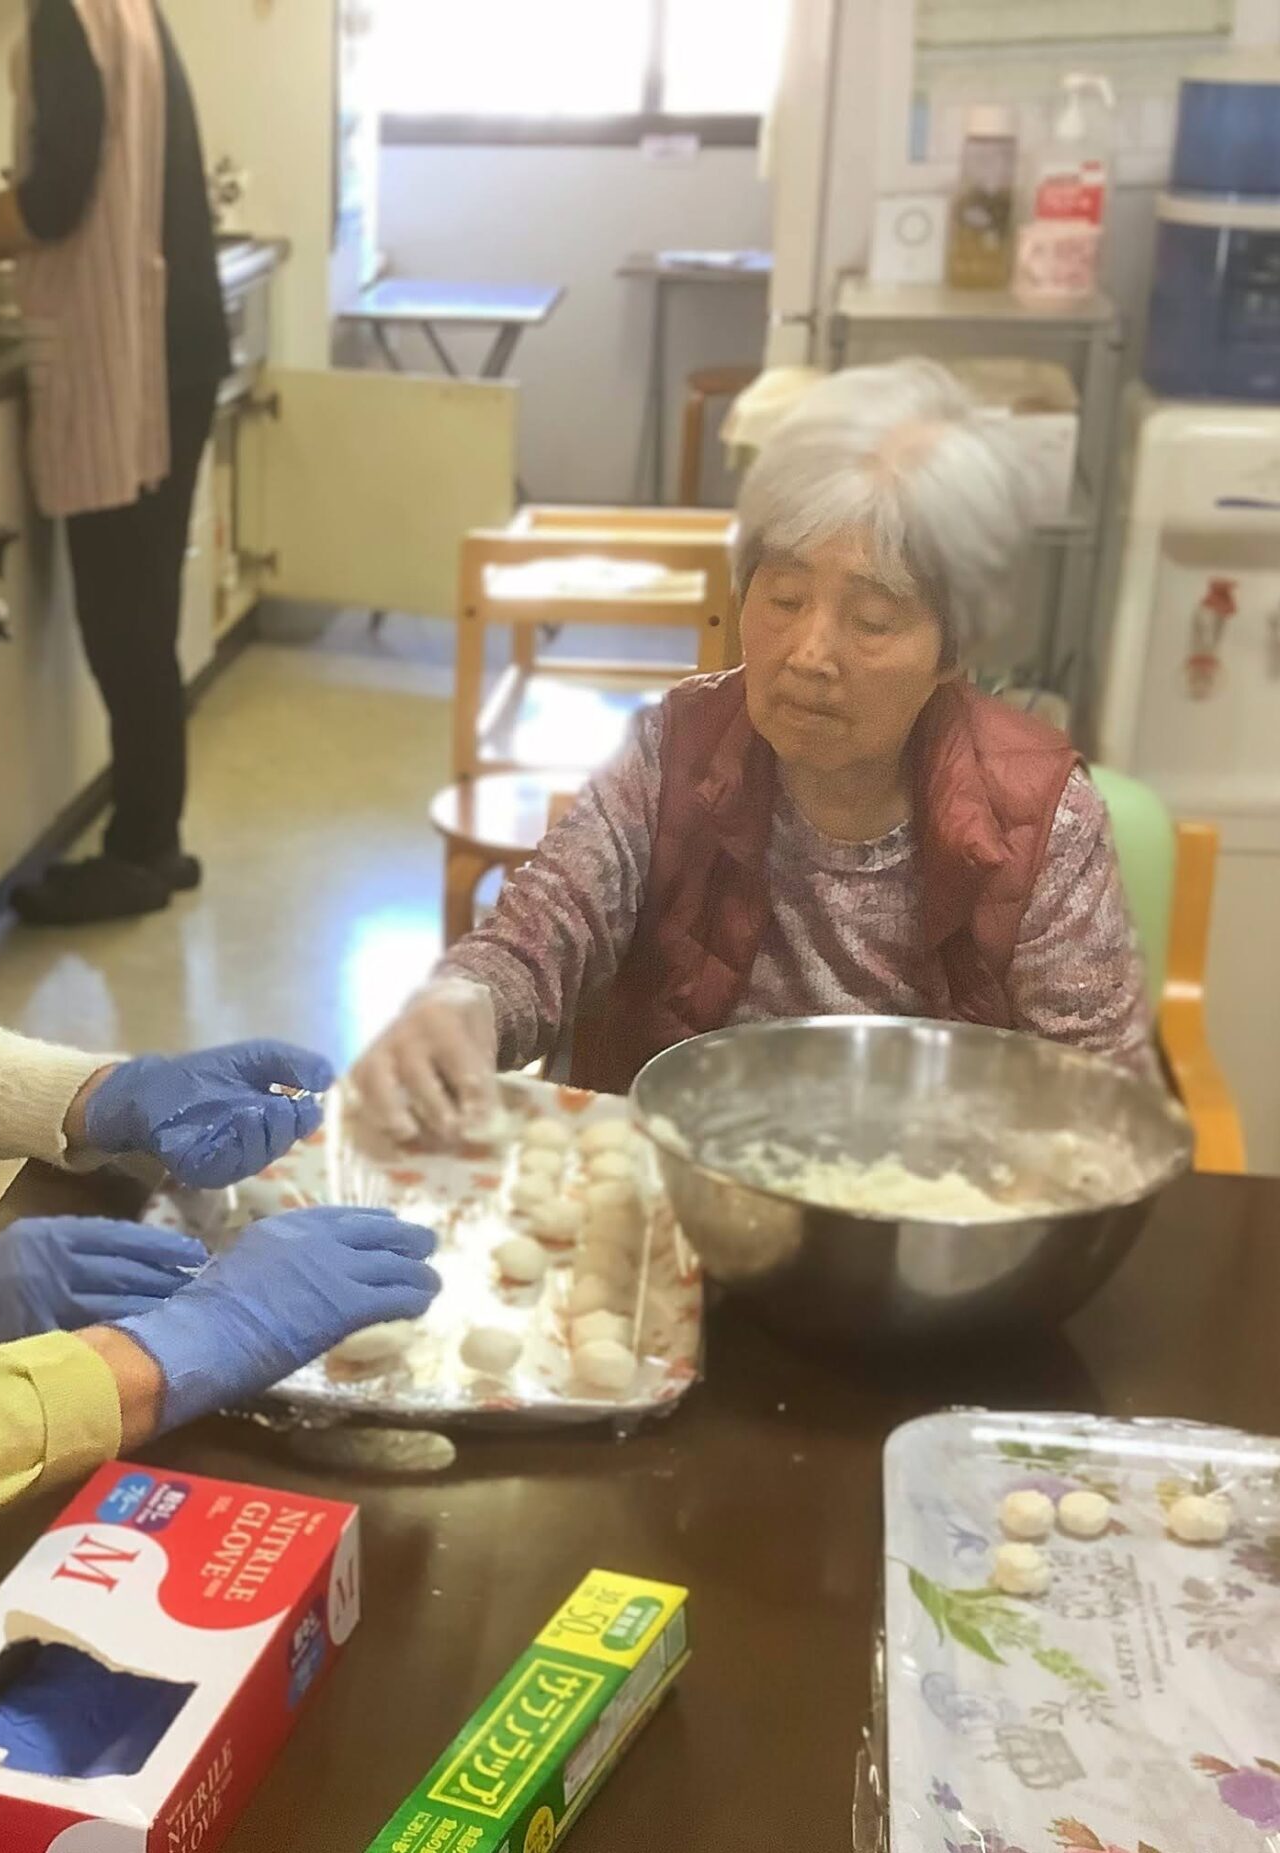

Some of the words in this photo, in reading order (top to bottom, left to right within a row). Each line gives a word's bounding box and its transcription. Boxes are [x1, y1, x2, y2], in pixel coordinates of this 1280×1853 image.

[50, 1533, 141, 1593] M
[200, 1501, 270, 1578] GLOVE
[224, 1506, 308, 1602] NITRILE
[459, 1674, 581, 1805] サランラップ
